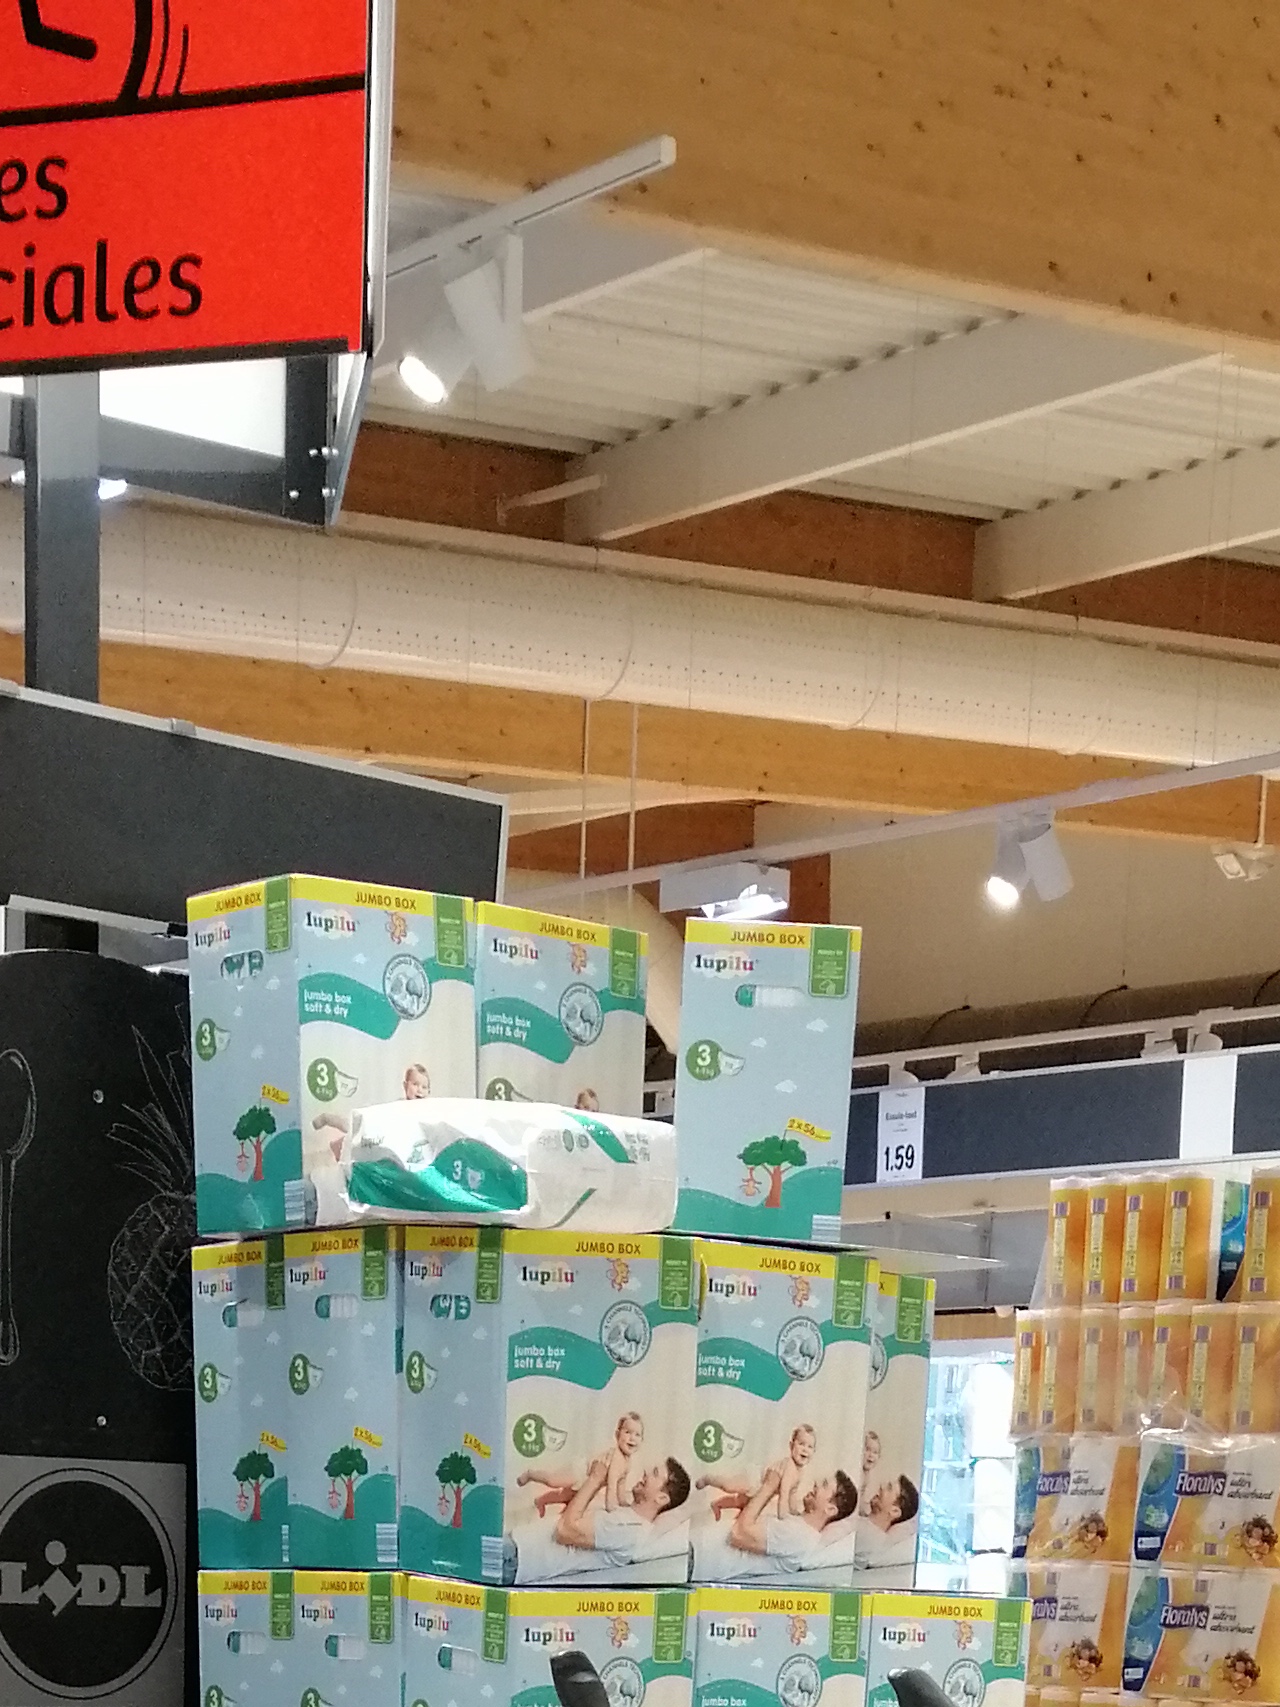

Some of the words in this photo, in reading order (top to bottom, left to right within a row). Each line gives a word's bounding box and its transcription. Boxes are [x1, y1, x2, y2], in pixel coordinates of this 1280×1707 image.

[355, 892, 391, 908] JUMBO
[394, 895, 417, 911] BOX
[306, 911, 358, 933] lupilu
[730, 931, 775, 945] JUMBO
[779, 932, 806, 947] BOX
[695, 953, 755, 973] lupilu
[696, 1045, 712, 1068] 3
[884, 1144, 915, 1171] 1.59
[575, 1241, 615, 1254] JUMBO
[618, 1242, 641, 1255] BOX
[760, 1258, 799, 1272] JUMBO
[800, 1260, 821, 1274] BOX
[521, 1266, 576, 1286] lupilu
[708, 1279, 759, 1297] lupilu
[514, 1345, 545, 1359] jumbo
[547, 1346, 566, 1358] box
[514, 1356, 534, 1369] soft
[545, 1357, 561, 1371] dry
[523, 1421, 536, 1441] 3
[704, 1426, 715, 1448] 3
[1176, 1473, 1225, 1495] Floralys
[576, 1600, 615, 1612] JUMBO
[617, 1601, 640, 1611] BOX
[758, 1599, 793, 1611] JUMBO
[796, 1600, 817, 1611] BOX
[927, 1604, 961, 1617] JUMBO
[963, 1606, 982, 1617] BOX
[1161, 1605, 1208, 1627] Floralys
[523, 1626, 576, 1645] lupilu
[710, 1621, 757, 1640] lupilu
[882, 1627, 927, 1644] lupilu
